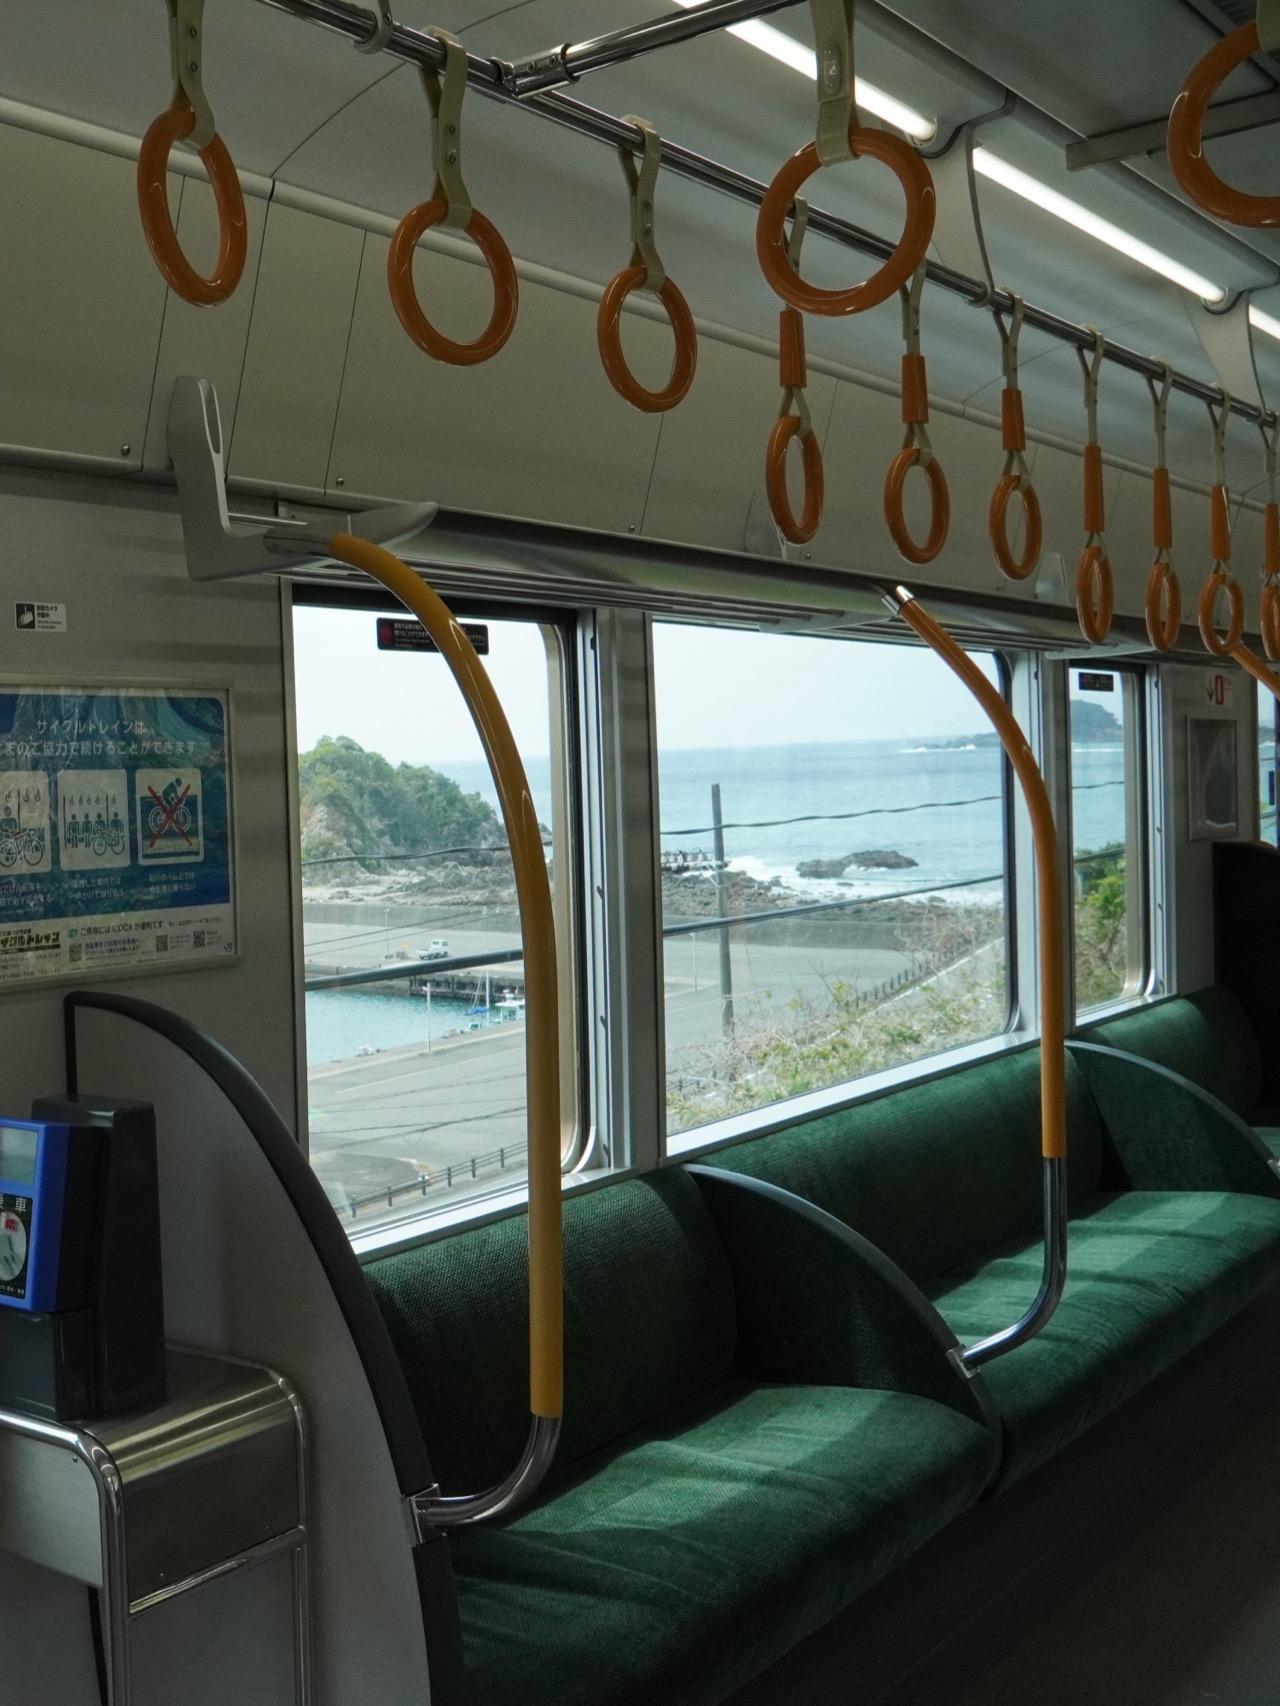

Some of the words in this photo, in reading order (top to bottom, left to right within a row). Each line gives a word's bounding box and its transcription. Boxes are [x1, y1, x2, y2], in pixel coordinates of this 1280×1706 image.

[36, 719, 146, 735] サイクルトレインは
